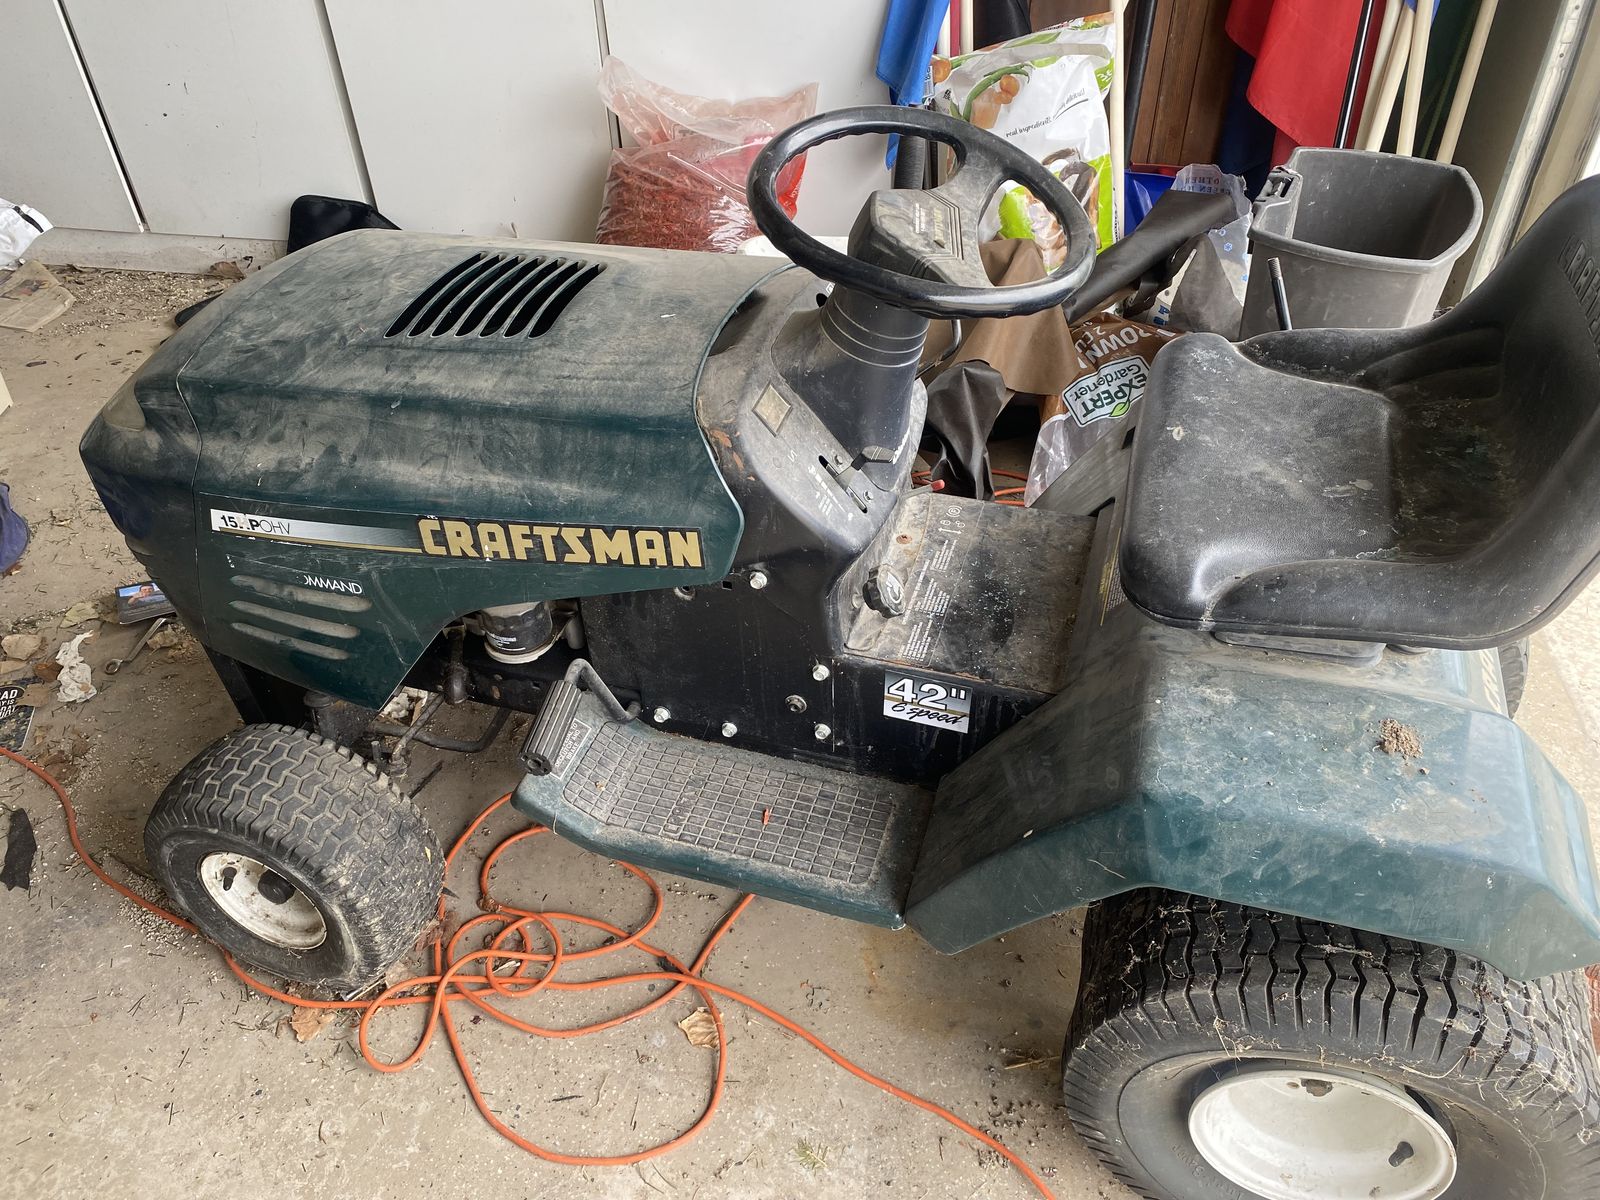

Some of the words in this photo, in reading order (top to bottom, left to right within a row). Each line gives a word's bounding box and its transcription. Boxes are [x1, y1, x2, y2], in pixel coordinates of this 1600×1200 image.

[1074, 363, 1142, 402] Gardener
[1081, 371, 1148, 418] EXPERT
[417, 518, 703, 568] CRAFTSMAN
[888, 678, 967, 711] 42"
[891, 702, 907, 712] 6
[906, 706, 963, 725] speed
